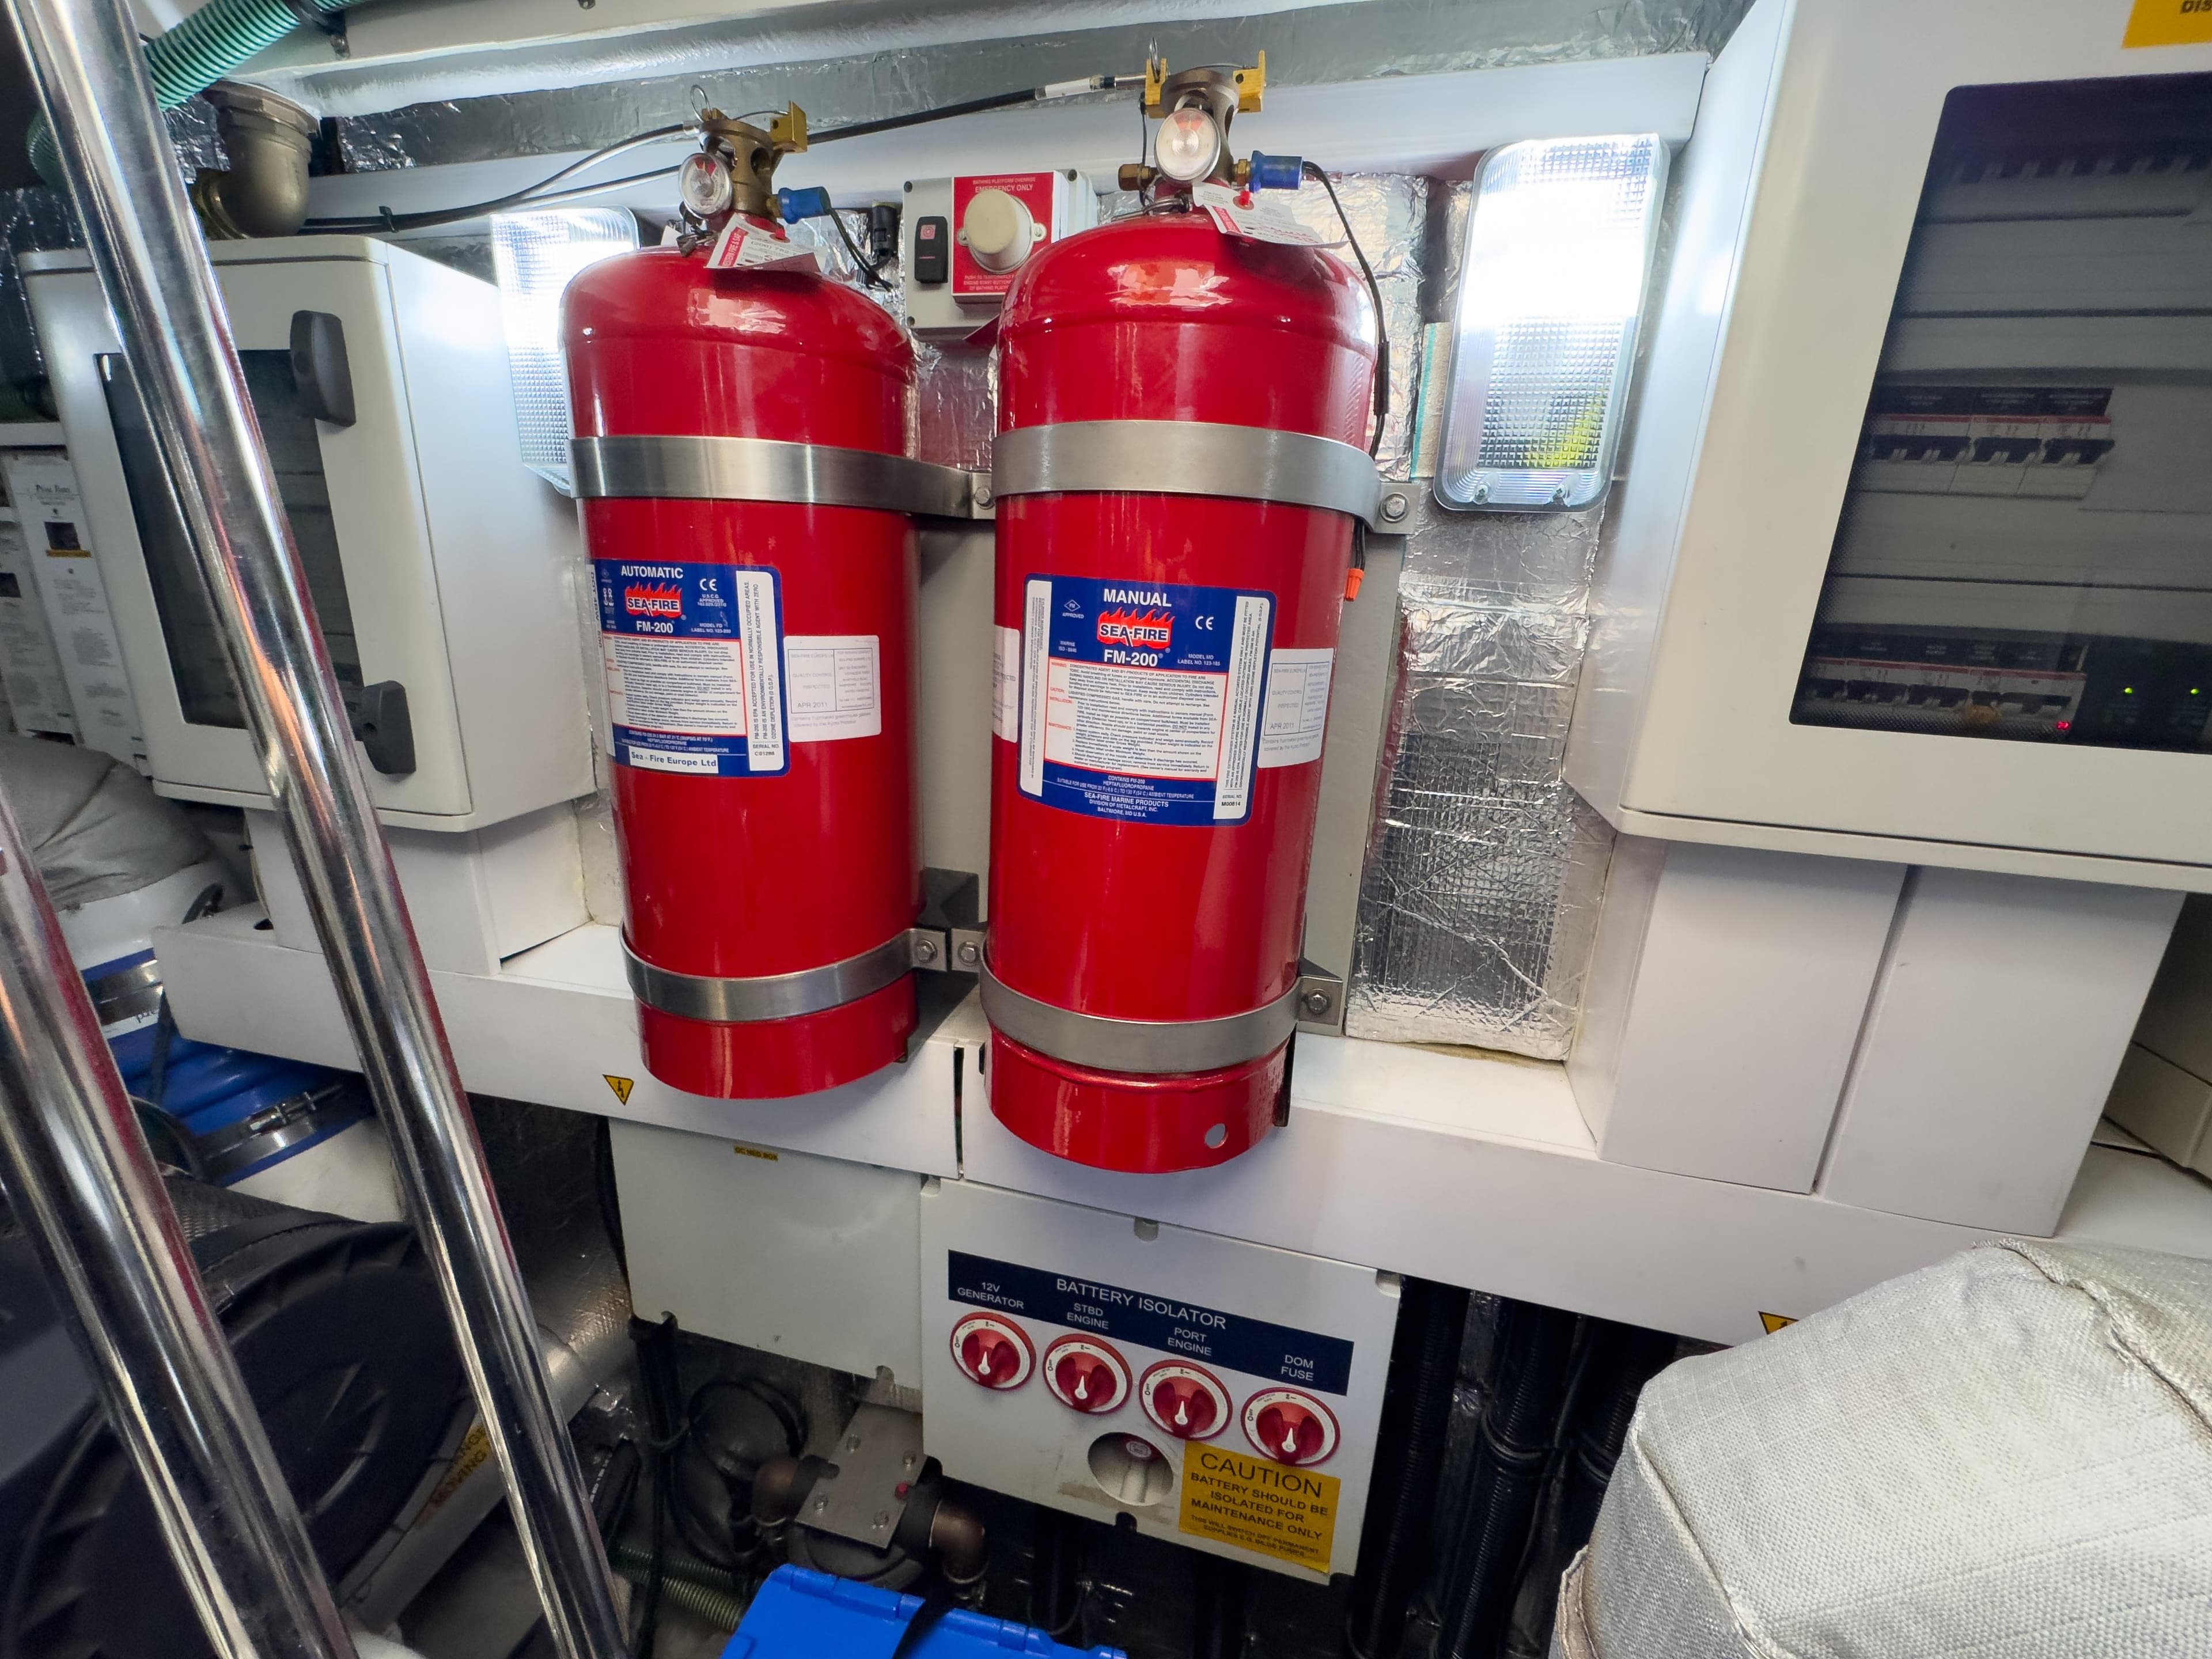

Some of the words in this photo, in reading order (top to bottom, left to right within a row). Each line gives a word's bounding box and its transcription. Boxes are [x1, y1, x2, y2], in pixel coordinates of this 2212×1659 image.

[621, 565, 684, 579] AUTOMATIC
[699, 578, 717, 591] CE
[627, 597, 680, 612] SEA-FIRE
[1103, 589, 1172, 607] MANUAL
[636, 620, 673, 634] FM-200
[1195, 616, 1214, 630] CE
[1100, 624, 1168, 641] SEA-FIRE
[1104, 649, 1158, 667] FM-200
[631, 752, 644, 760] Sea
[650, 754, 664, 763] Fire
[667, 757, 698, 767] Europe
[1108, 775, 1130, 783] CONTAINS
[1085, 791, 1110, 802] SEA-FIRE
[1111, 796, 1134, 805] MARINE
[1135, 798, 1169, 808] PRODUCTS
[982, 1282, 1000, 1293] 12V
[957, 1287, 1024, 1309] GENERATOR
[1056, 1278, 1133, 1306] BATTERY
[1139, 1297, 1226, 1330] ISOLATOR
[1074, 1303, 1103, 1316] STBD
[1067, 1312, 1109, 1330] ENGINE
[1174, 1327, 1206, 1342] PORT
[1168, 1338, 1212, 1356] ENGINE
[1285, 1354, 1313, 1369] DOM
[1281, 1366, 1314, 1381] FUSE
[1200, 1453, 1322, 1498] CAUTION
[1191, 1472, 1249, 1494] BATTERY
[1252, 1489, 1306, 1510] SHOULD
[1310, 1504, 1328, 1516] BE
[1211, 1491, 1273, 1515] ISOLATED
[1277, 1509, 1305, 1523] FOR
[1191, 1498, 1283, 1531] MAINTENANCE
[1287, 1525, 1323, 1540] ONLY
[1191, 1515, 1207, 1524] THIS
[1208, 1519, 1225, 1528] WILL
[1227, 1524, 1255, 1537] SWITCH
[1273, 1537, 1319, 1554] PERMANENT
[1203, 1524, 1238, 1539] SUPPLIES
